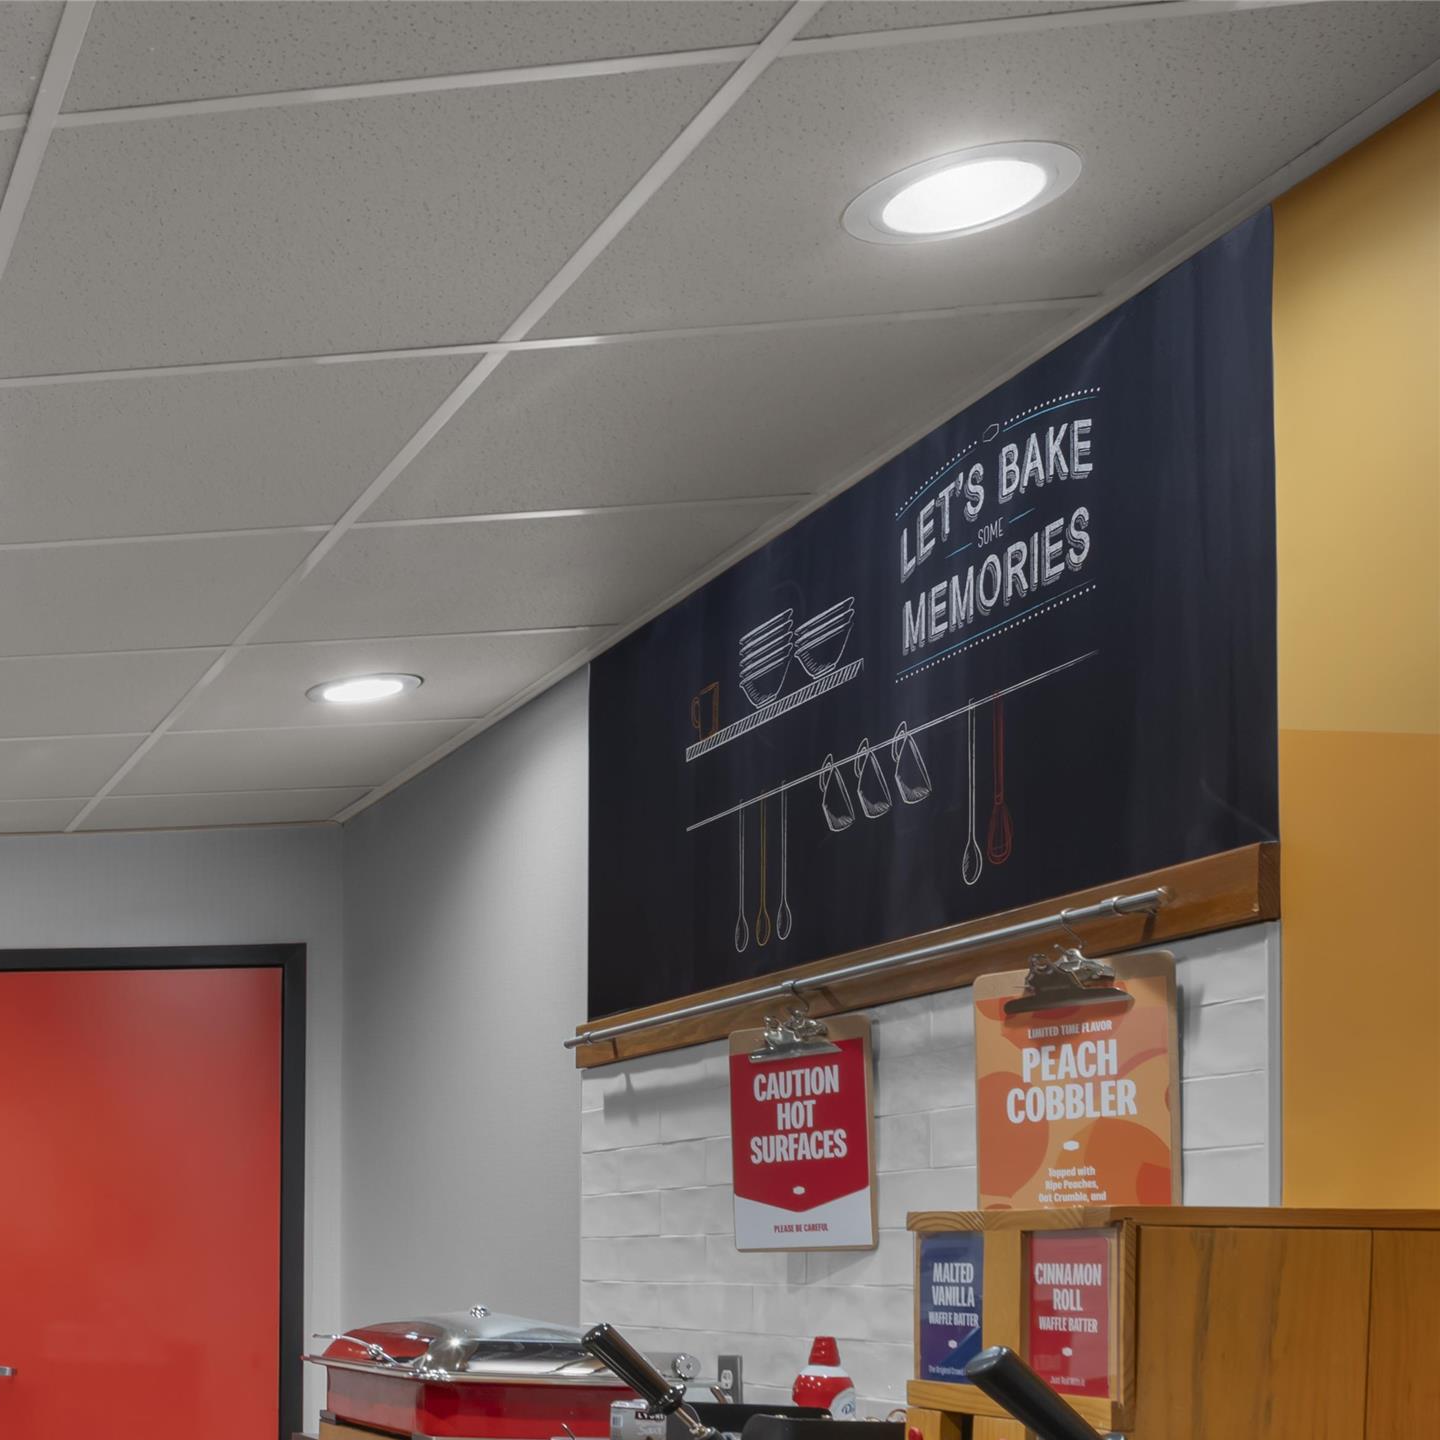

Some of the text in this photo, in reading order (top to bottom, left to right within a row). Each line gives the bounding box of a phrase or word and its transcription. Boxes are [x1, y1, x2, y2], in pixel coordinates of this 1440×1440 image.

[900, 418, 1093, 584] LET'S BAKE
[977, 516, 1004, 548] SOME
[902, 506, 1090, 656] MEMORIES
[1028, 1020, 1113, 1039] LIMITED TIME FLAVOR
[1022, 1039, 1119, 1083] PEACH
[753, 1065, 839, 1102] CAUTION
[1006, 1079, 1138, 1124] COBBLER
[777, 1100, 816, 1130] HOT
[750, 1129, 848, 1164] SURFACES
[1048, 1166, 1096, 1179] Topped with
[774, 1224, 794, 1233] PLEASE
[803, 1223, 828, 1232] CAREFUL
[933, 1263, 974, 1283] MALTED
[1034, 1262, 1102, 1286] CINNAMON
[932, 1285, 975, 1307] VANILLA
[1052, 1288, 1083, 1311] ROLL
[928, 1311, 979, 1327] WAFFLE BATTER
[1038, 1316, 1098, 1333] WAFFLE BATTER
